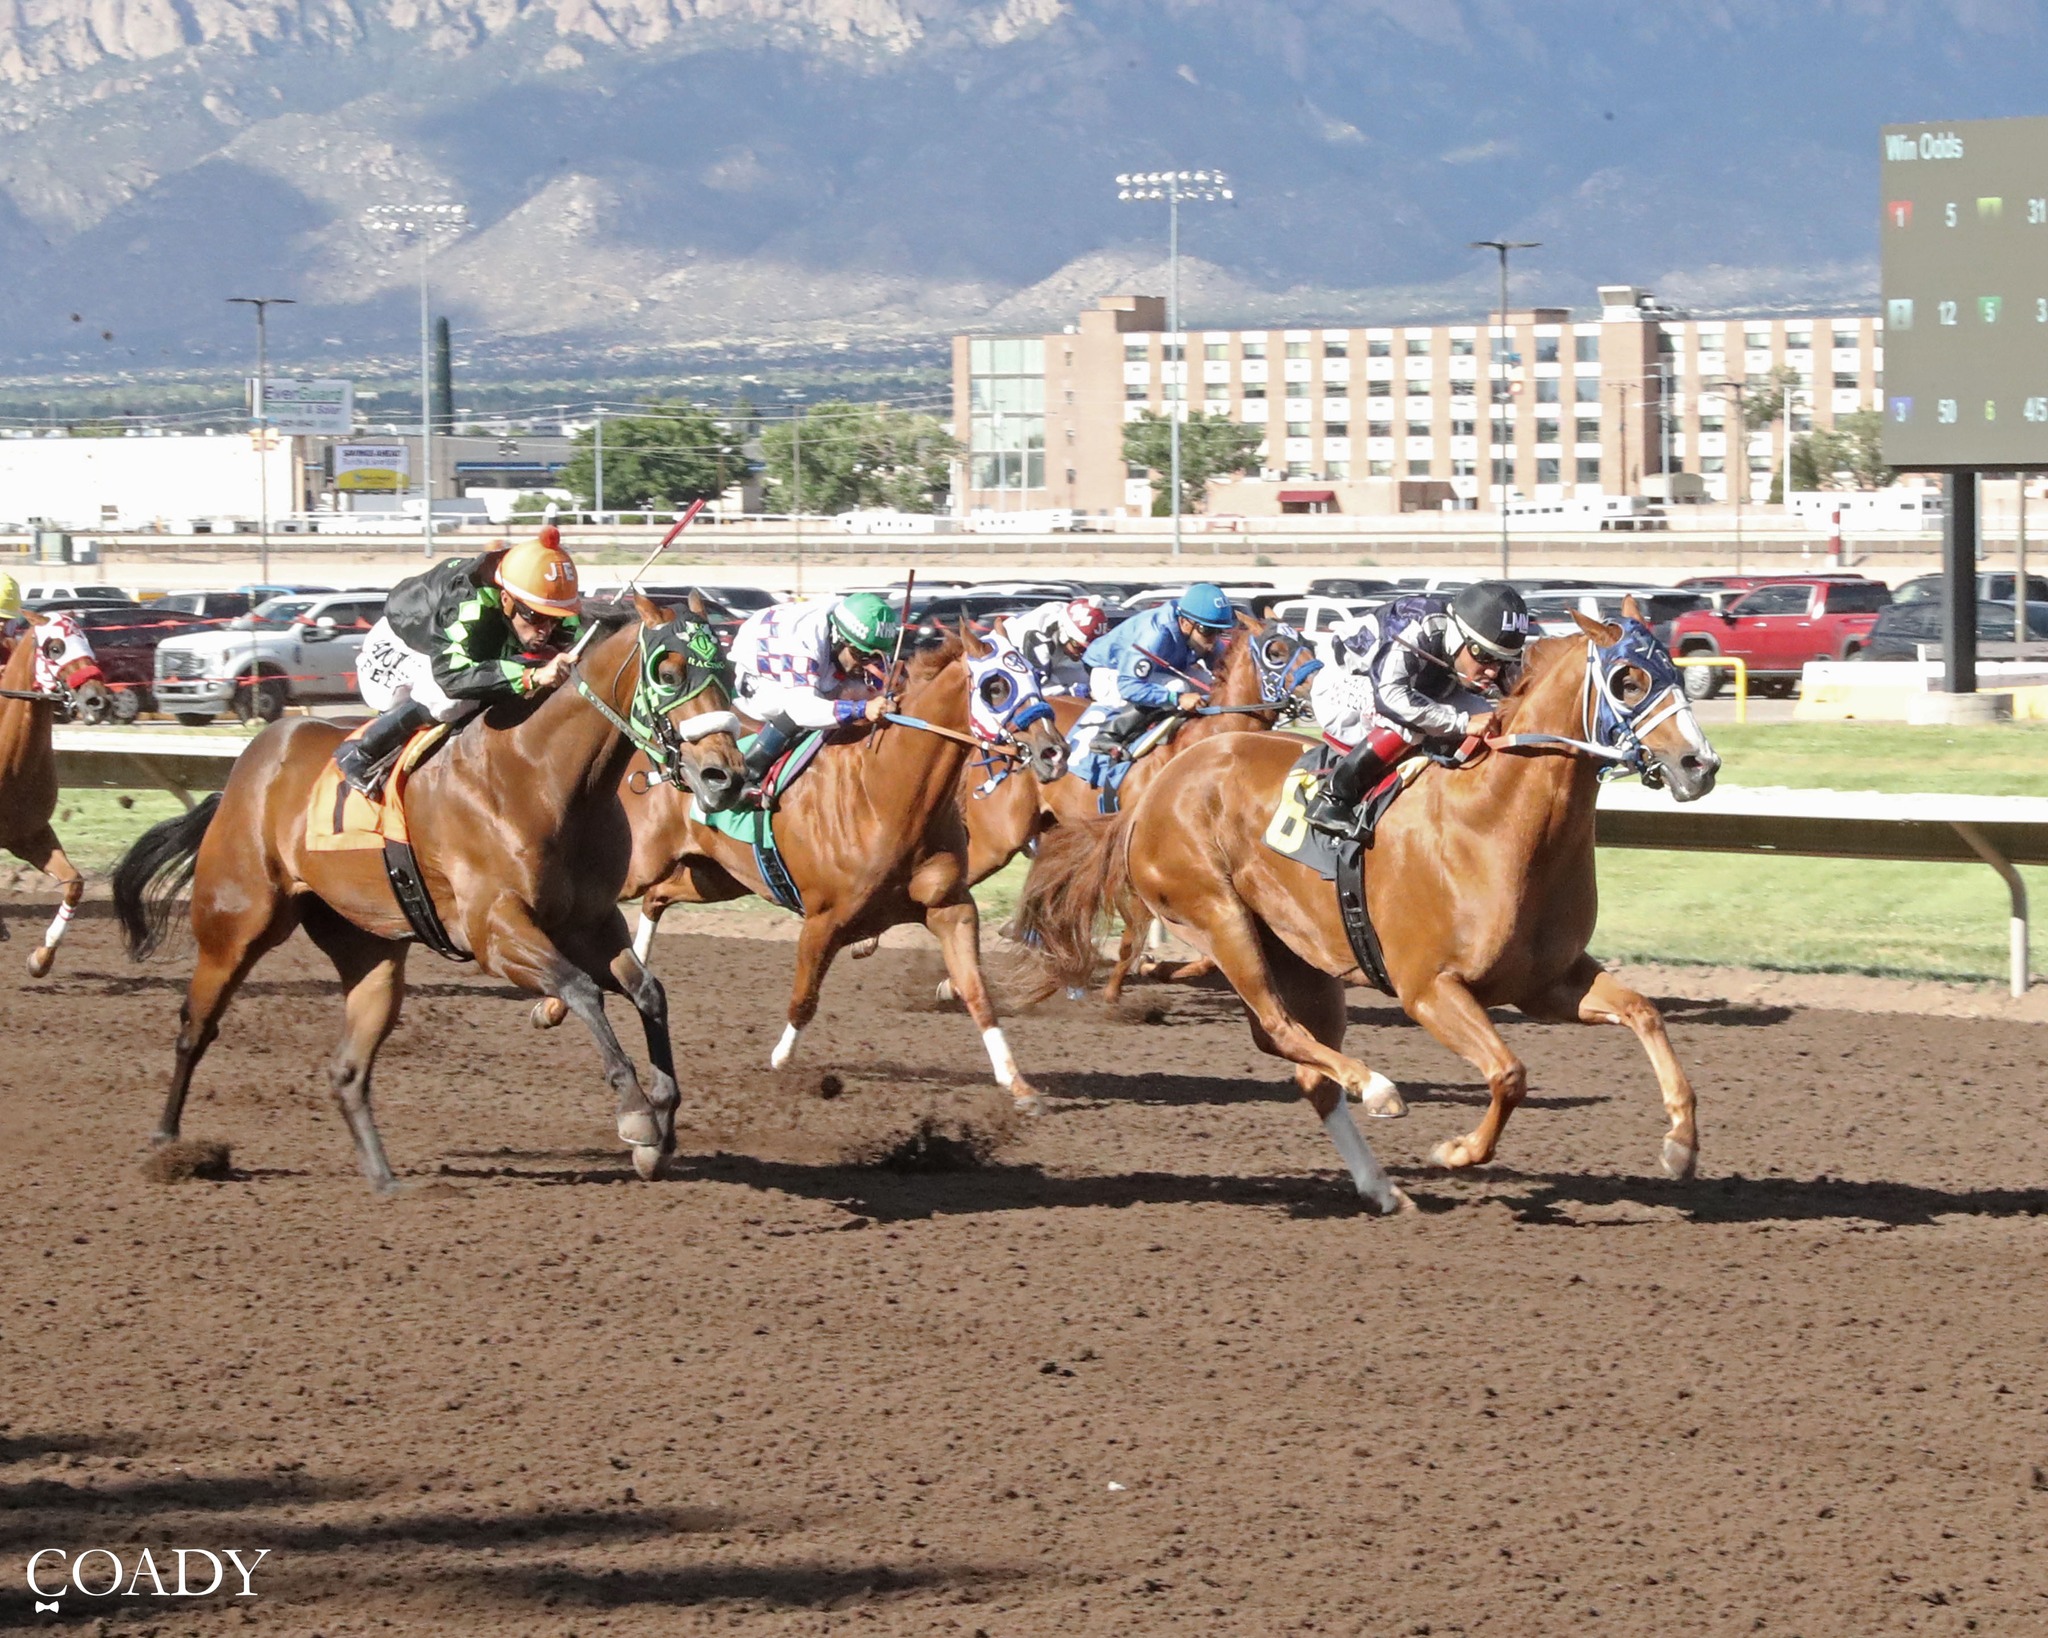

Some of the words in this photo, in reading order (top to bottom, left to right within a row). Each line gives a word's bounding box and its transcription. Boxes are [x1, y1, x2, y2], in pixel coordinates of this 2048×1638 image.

[1885, 133, 1917, 161] Win
[1920, 131, 1963, 160] Odds
[1895, 207, 1904, 227] 1
[1945, 203, 1957, 227] 5
[2027, 199, 2046, 224] 31
[1938, 301, 1957, 325] 12
[2036, 298, 2048, 322] 3
[1938, 399, 1957, 423] 50
[544, 562, 575, 582] JE
[1134, 660, 1150, 677] 3
[1266, 768, 1319, 853] 6
